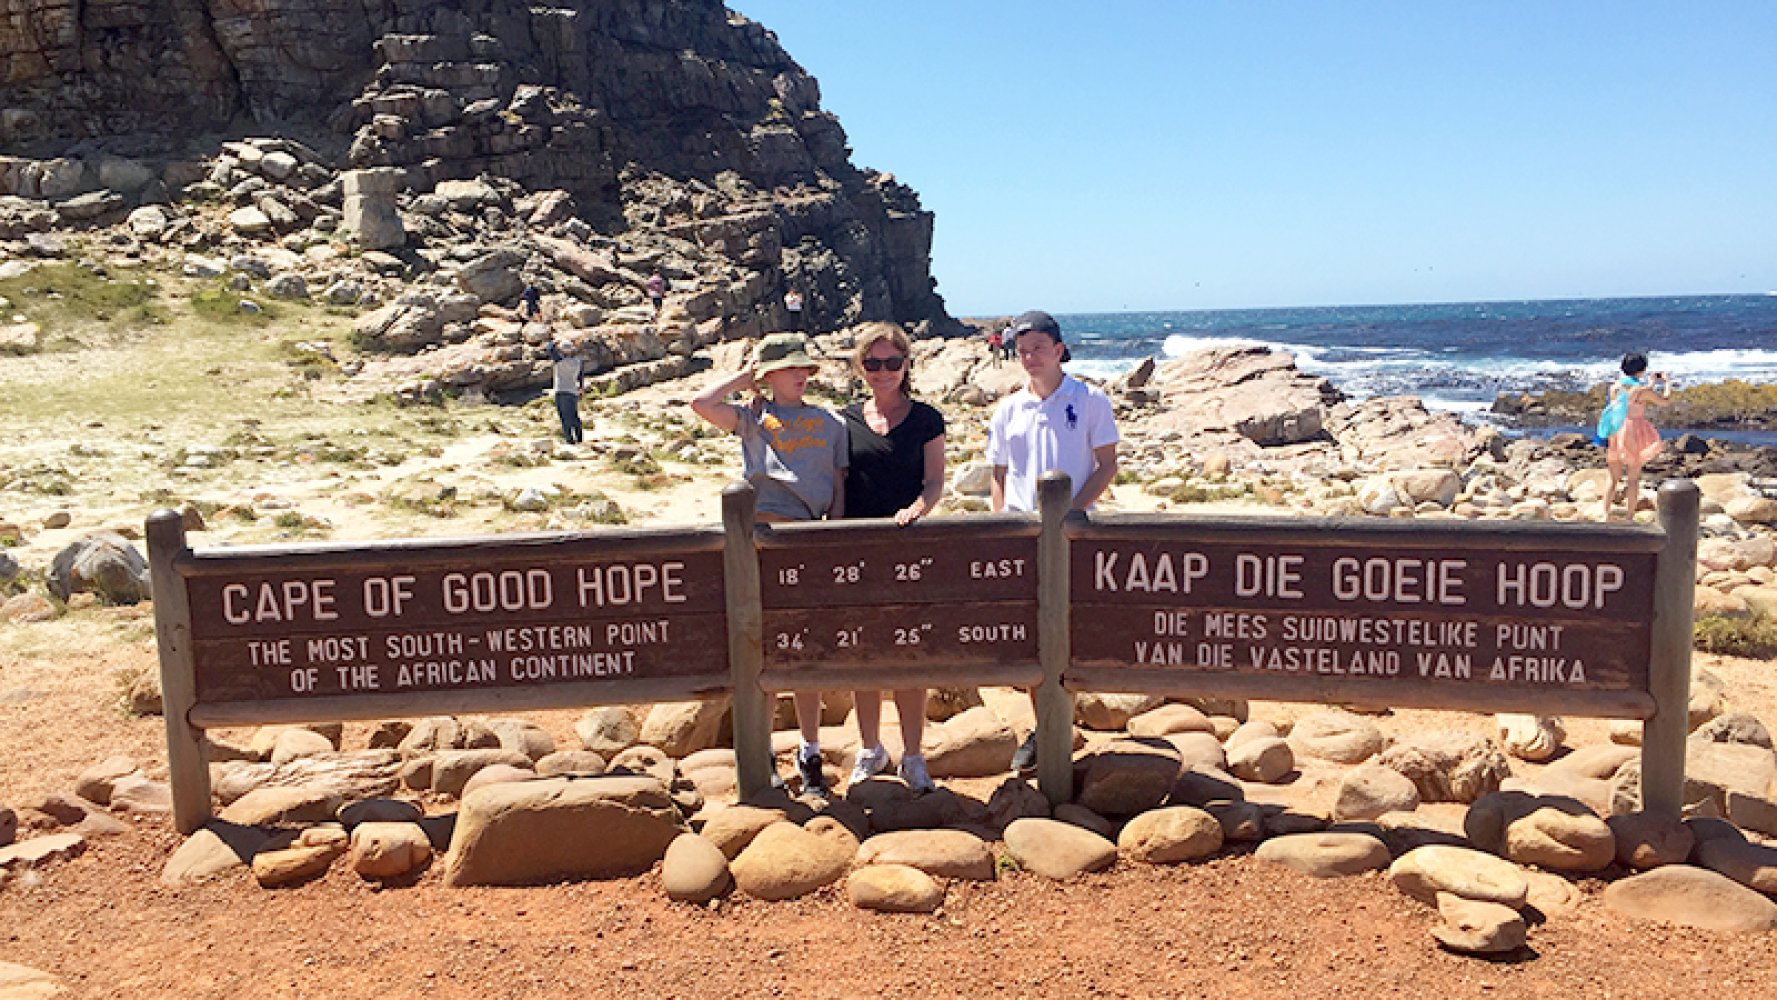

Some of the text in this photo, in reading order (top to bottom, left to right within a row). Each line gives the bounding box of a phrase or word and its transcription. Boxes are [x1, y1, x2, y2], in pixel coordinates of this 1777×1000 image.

[970, 559, 1025, 577] EAST
[1095, 551, 1625, 608] KAAP DIE GOEIE HOOP
[223, 563, 687, 624] CAPE OF GOOD HOPE
[248, 642, 292, 666] THE
[308, 637, 369, 662] MOST
[606, 621, 670, 646] POINT
[959, 625, 1025, 643] SOUTH
[1154, 612, 1564, 650] DIE MEES SUIDWESTELIKE PUNT
[290, 650, 635, 692] OF THE AFRICAN CONTINENT
[1134, 641, 1586, 683] VAN DIE VASTELAND VAN AFRIKA
